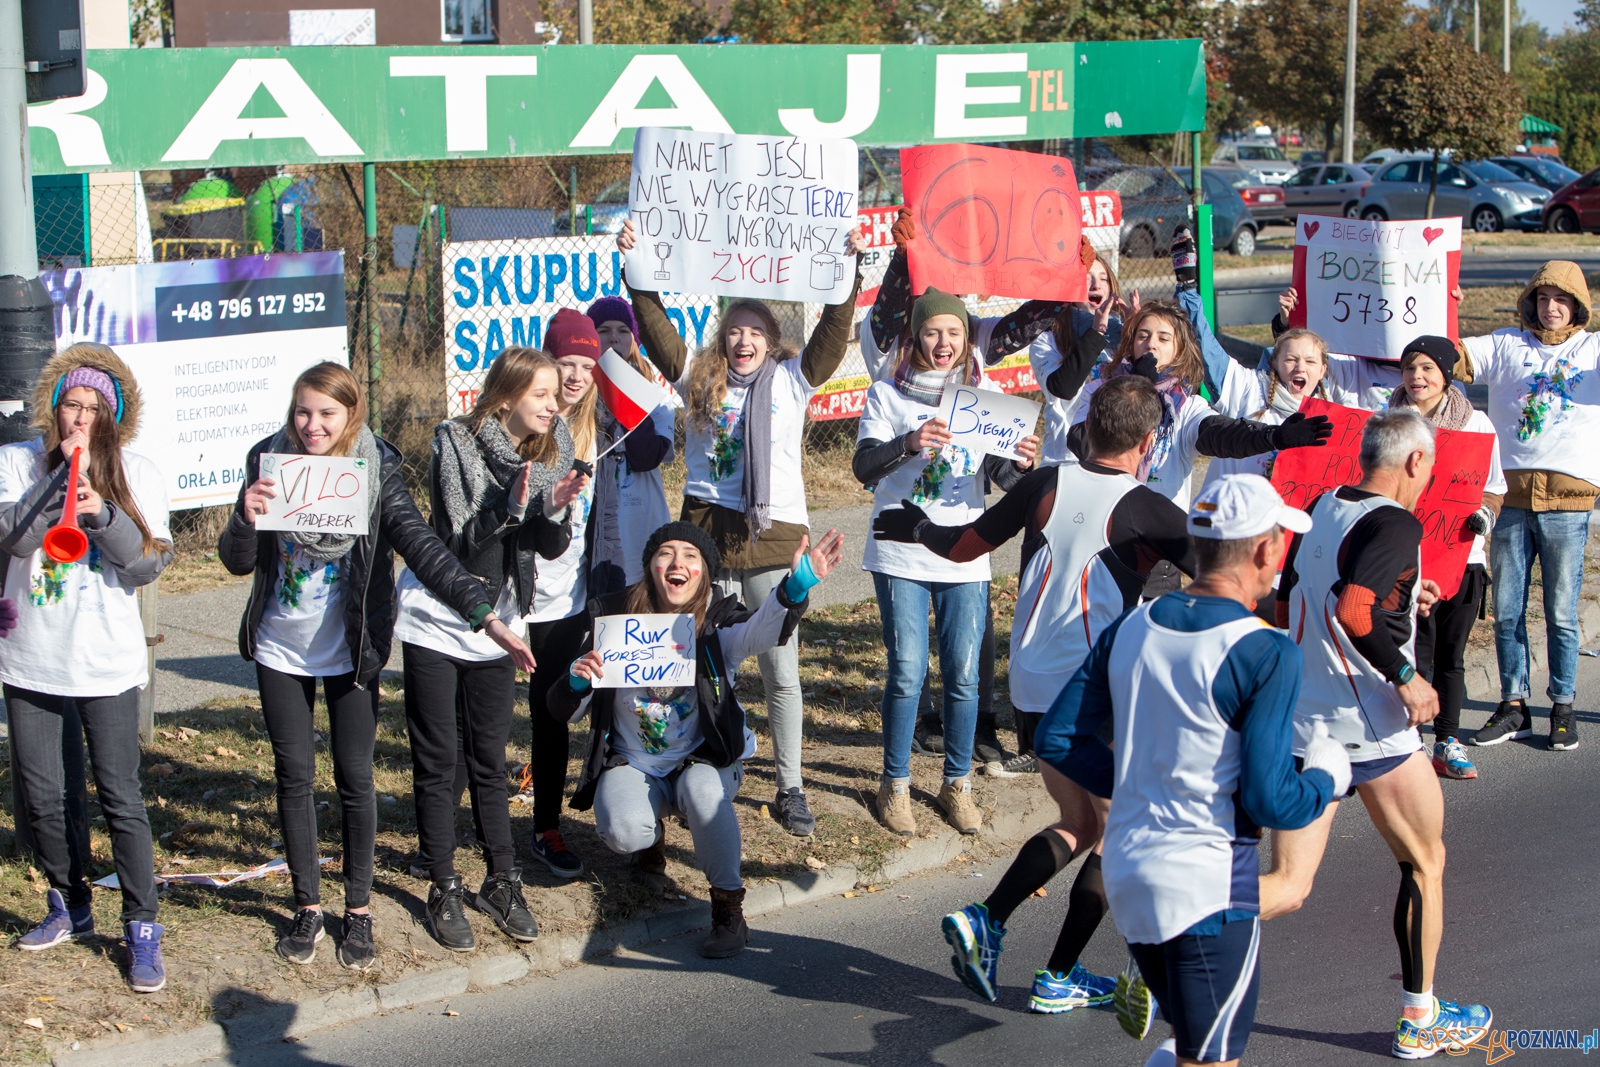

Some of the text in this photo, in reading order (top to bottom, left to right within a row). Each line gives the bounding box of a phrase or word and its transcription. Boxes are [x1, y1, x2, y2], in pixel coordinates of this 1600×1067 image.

[1027, 70, 1069, 112] TEL
[655, 136, 824, 180] NAWET JEŚLI
[635, 173, 853, 218] NIE WYGRASZ TERAZ
[632, 206, 842, 255] TO JUŻ WYGRYWASZ
[1331, 221, 1406, 249] BIEGNIJ
[711, 247, 793, 284] ŻYCIE
[1317, 251, 1442, 287] BOŻENA
[171, 291, 326, 323] +48 796 127 952
[1332, 292, 1418, 325] 5738
[174, 355, 277, 377] INTELIGENTNY DOM
[175, 378, 269, 399] PROGRAMOWANIE
[176, 403, 248, 422] ELEKTRONIKA
[177, 426, 249, 444] AUTOMATYKA
[178, 470, 218, 490] ORŁA
[317, 466, 360, 500] LO
[295, 512, 356, 528] PADEREK
[625, 618, 669, 645] RUN
